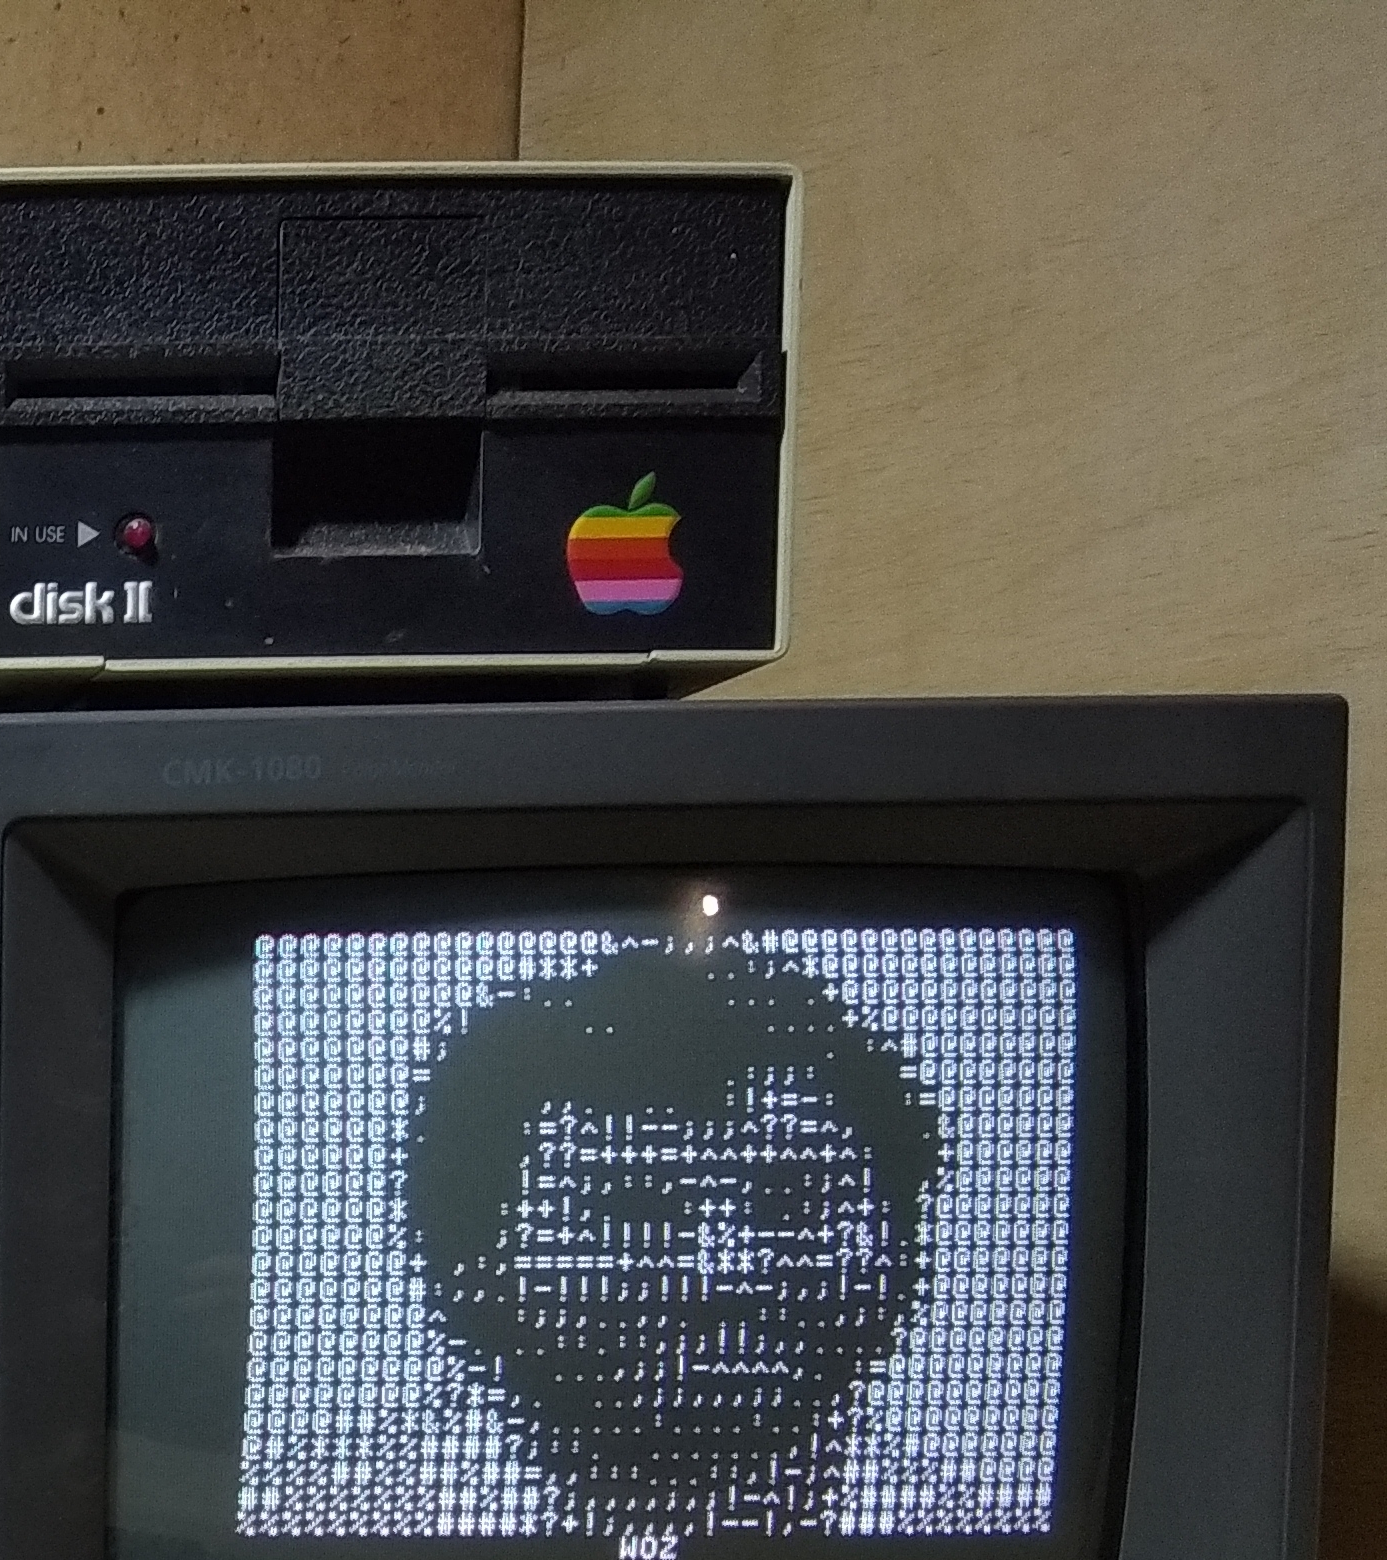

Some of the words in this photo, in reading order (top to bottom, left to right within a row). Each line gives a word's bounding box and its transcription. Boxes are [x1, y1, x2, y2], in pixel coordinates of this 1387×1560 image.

[10, 525, 30, 542] IN
[34, 525, 66, 542] USE
[9, 581, 116, 626] disk
[162, 755, 323, 788] CMK-1080
